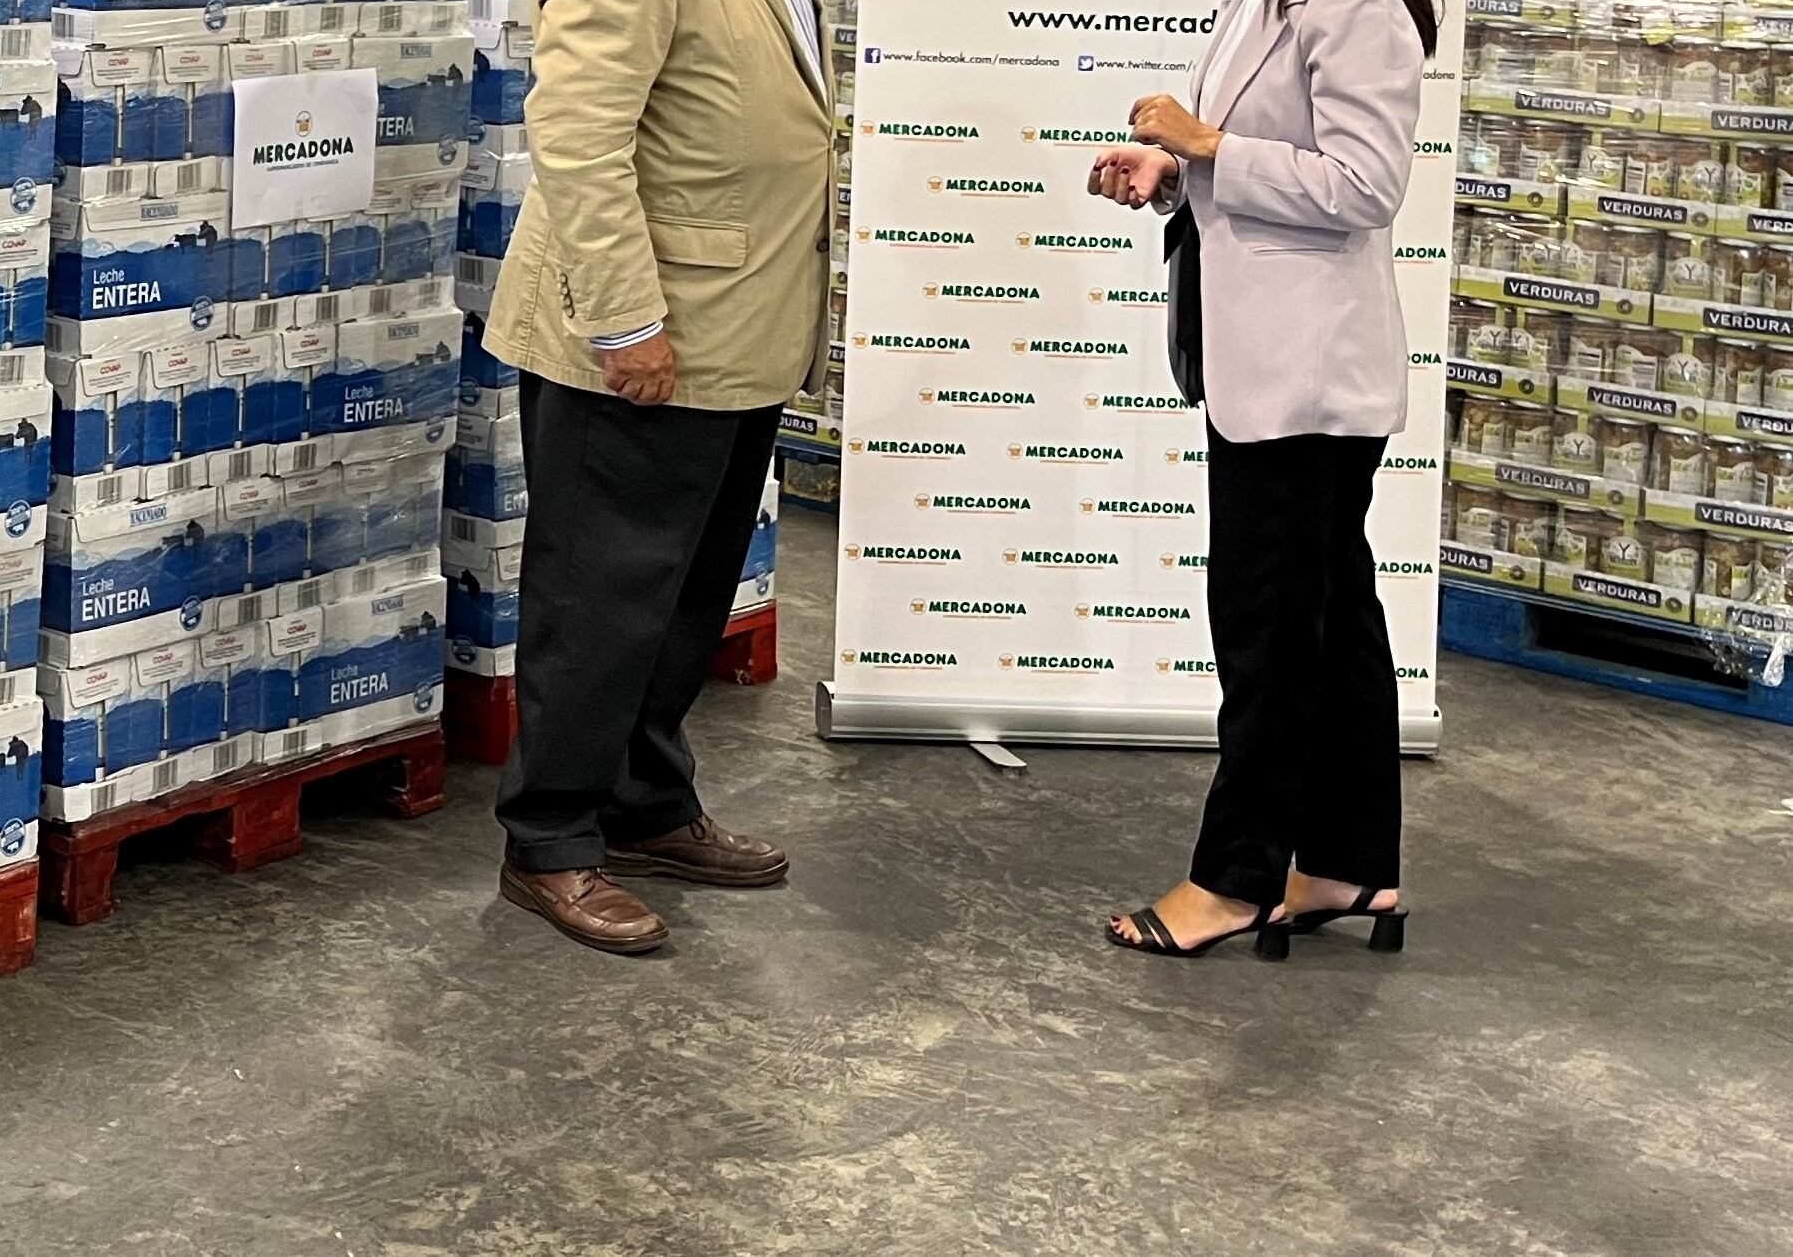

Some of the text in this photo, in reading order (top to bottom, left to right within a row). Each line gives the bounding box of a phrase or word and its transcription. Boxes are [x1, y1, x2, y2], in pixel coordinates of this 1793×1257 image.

[1008, 9, 1218, 33] www.mercad
[883, 51, 1060, 67] www.facebook.com/mercadona
[1096, 59, 1195, 72] www.twitter.com/
[1520, 93, 1607, 115] VERDURAS
[377, 116, 414, 137] TERA
[879, 123, 979, 138] MERCADONA
[1716, 114, 1793, 132] VERDURA
[253, 137, 354, 165] MERCADONA
[946, 180, 1045, 194] MERCADONA
[1456, 182, 1507, 198] DURAS
[1603, 200, 1683, 221] VERDURAS
[1752, 218, 1793, 233] VERD
[875, 231, 975, 244] MERCADONA
[1034, 235, 1133, 249] MERCADONA
[1394, 247, 1447, 259] ADONA
[93, 269, 125, 285] Leche
[93, 281, 161, 309] ENTERA
[942, 285, 1040, 299] MERCADONA
[1107, 290, 1168, 303] MERCAD
[1509, 282, 1595, 305] VERDURAS
[1709, 312, 1793, 333] VERDURA
[871, 336, 970, 350] MERCADONA
[1030, 341, 1128, 355] MERCADONA
[1446, 367, 1498, 385] DURAS
[937, 391, 1035, 405] MERCADONA
[1102, 396, 1200, 410] MERCADON
[1592, 391, 1673, 415] VERDURAS
[344, 398, 403, 423] ENTERA
[1741, 415, 1793, 433] VERDU
[867, 441, 965, 455] MERCADONA
[1025, 447, 1123, 461] MERCADONA
[1379, 457, 1437, 470] ADONA
[1499, 469, 1586, 495] VERDURAS
[933, 497, 1031, 510] MERCADONA
[1098, 501, 1195, 515] MERCADONA
[863, 547, 961, 561] MERCADONA
[1021, 551, 1119, 565] MERCADONA
[1440, 553, 1489, 570] DURAS
[1375, 562, 1433, 574] ADONA
[83, 578, 114, 594] Leche
[1577, 579, 1658, 604] VERDURAS
[82, 587, 150, 621] ENTERA
[928, 602, 1027, 615] MERCADONA
[1093, 606, 1191, 620] MERCADONA
[859, 652, 957, 666] MERCADONA
[1017, 657, 1115, 670] MERCADONA
[331, 672, 388, 704] ENTERA
